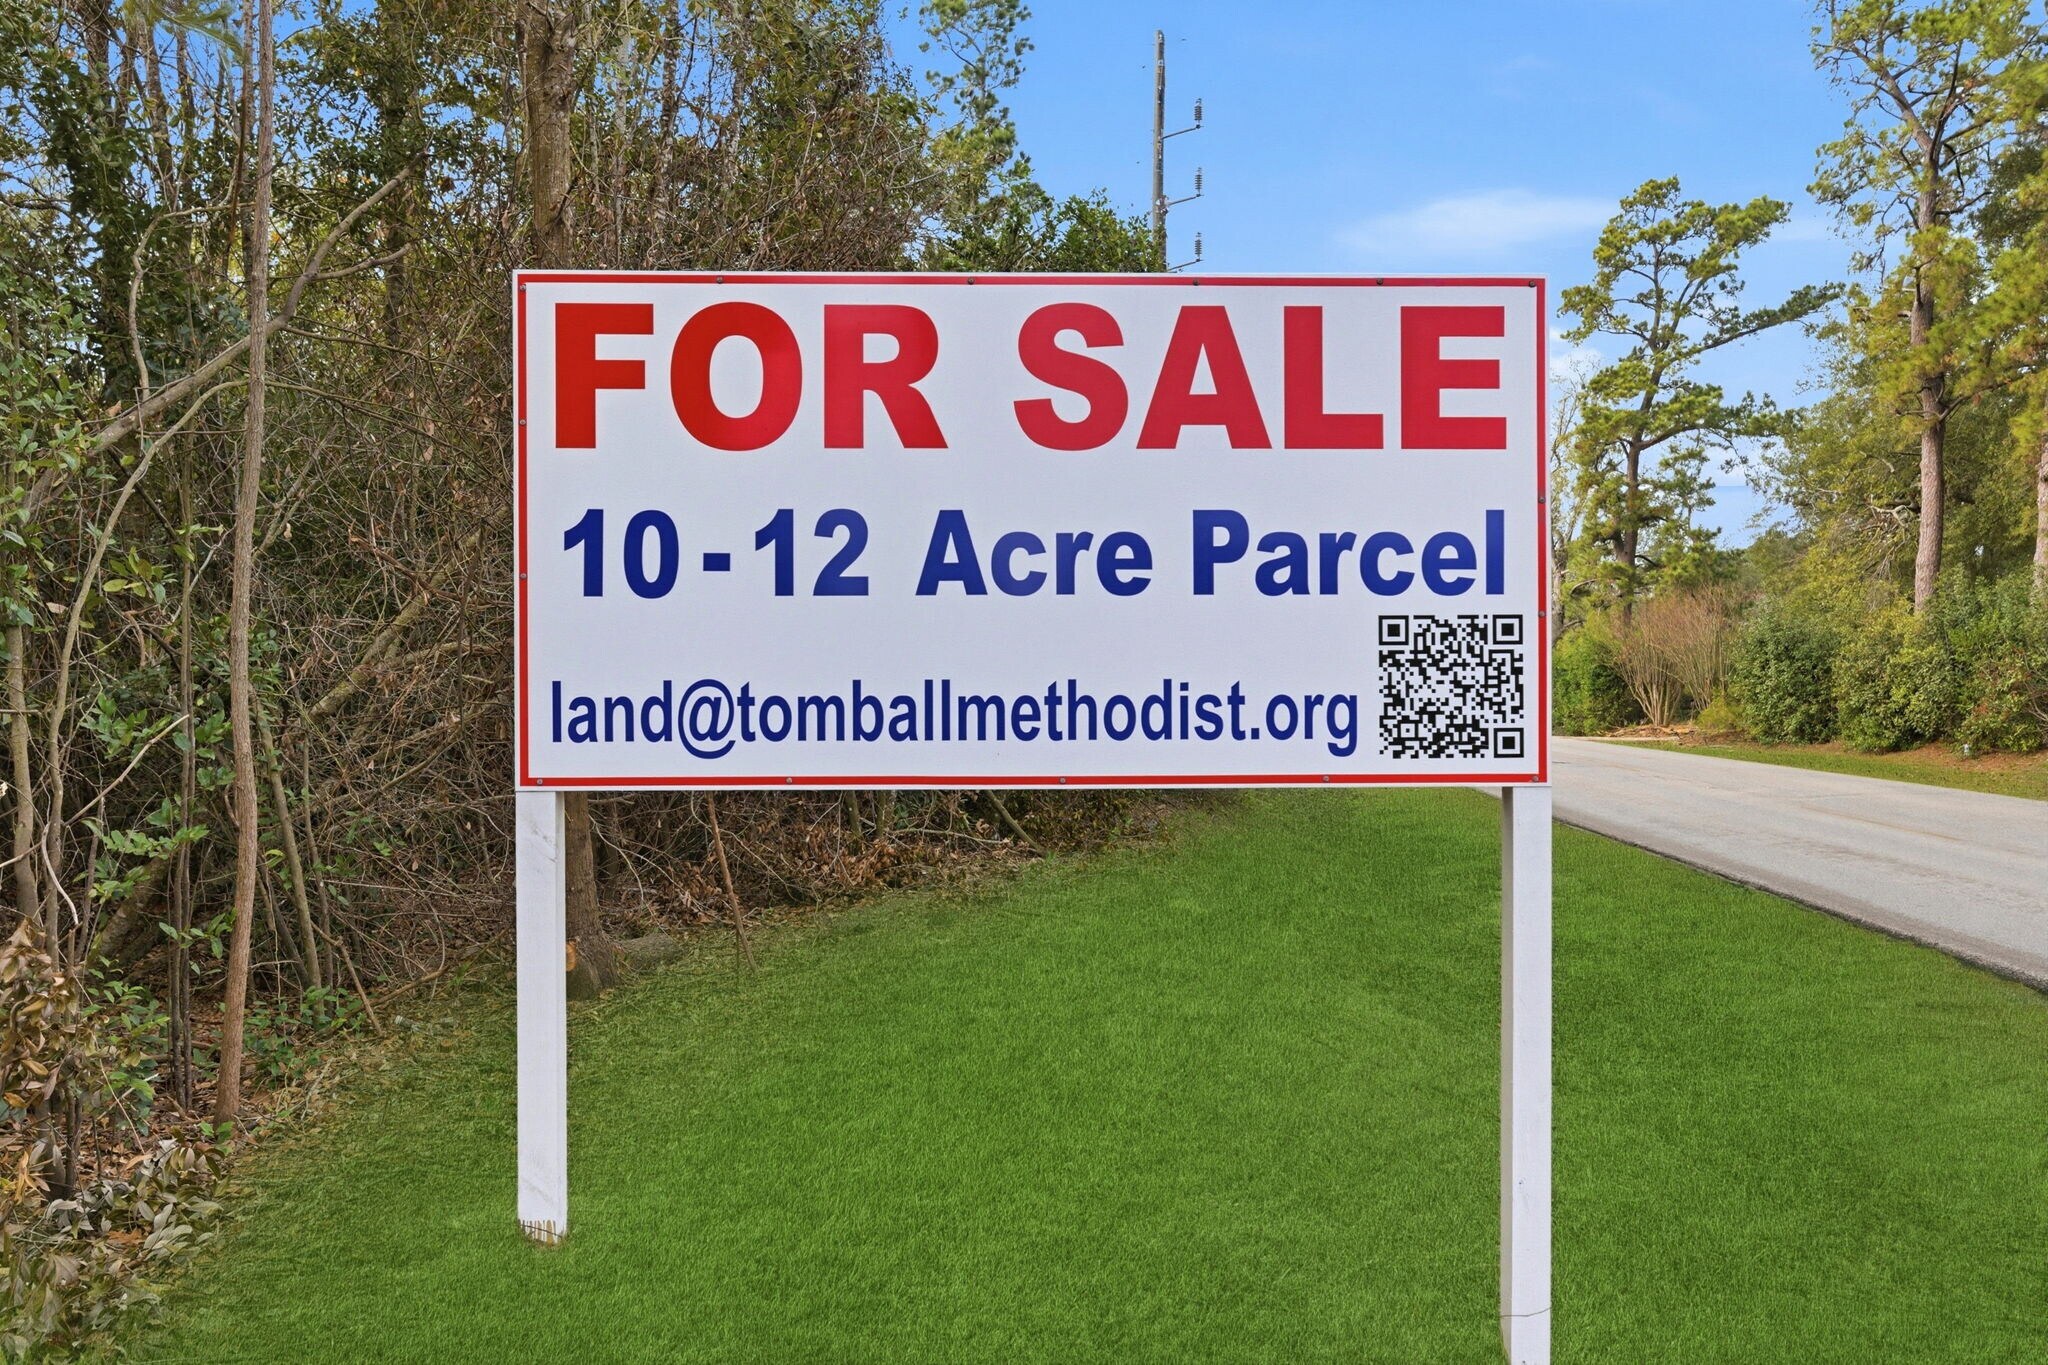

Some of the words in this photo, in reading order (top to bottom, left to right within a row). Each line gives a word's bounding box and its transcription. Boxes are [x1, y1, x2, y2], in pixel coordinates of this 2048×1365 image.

[555, 303, 947, 451] FOR
[1015, 303, 1507, 451] SALE
[915, 509, 1152, 597] Acre
[1193, 509, 1505, 597] Parcel
[551, 679, 1358, 759] land@tomballmethodist.org
